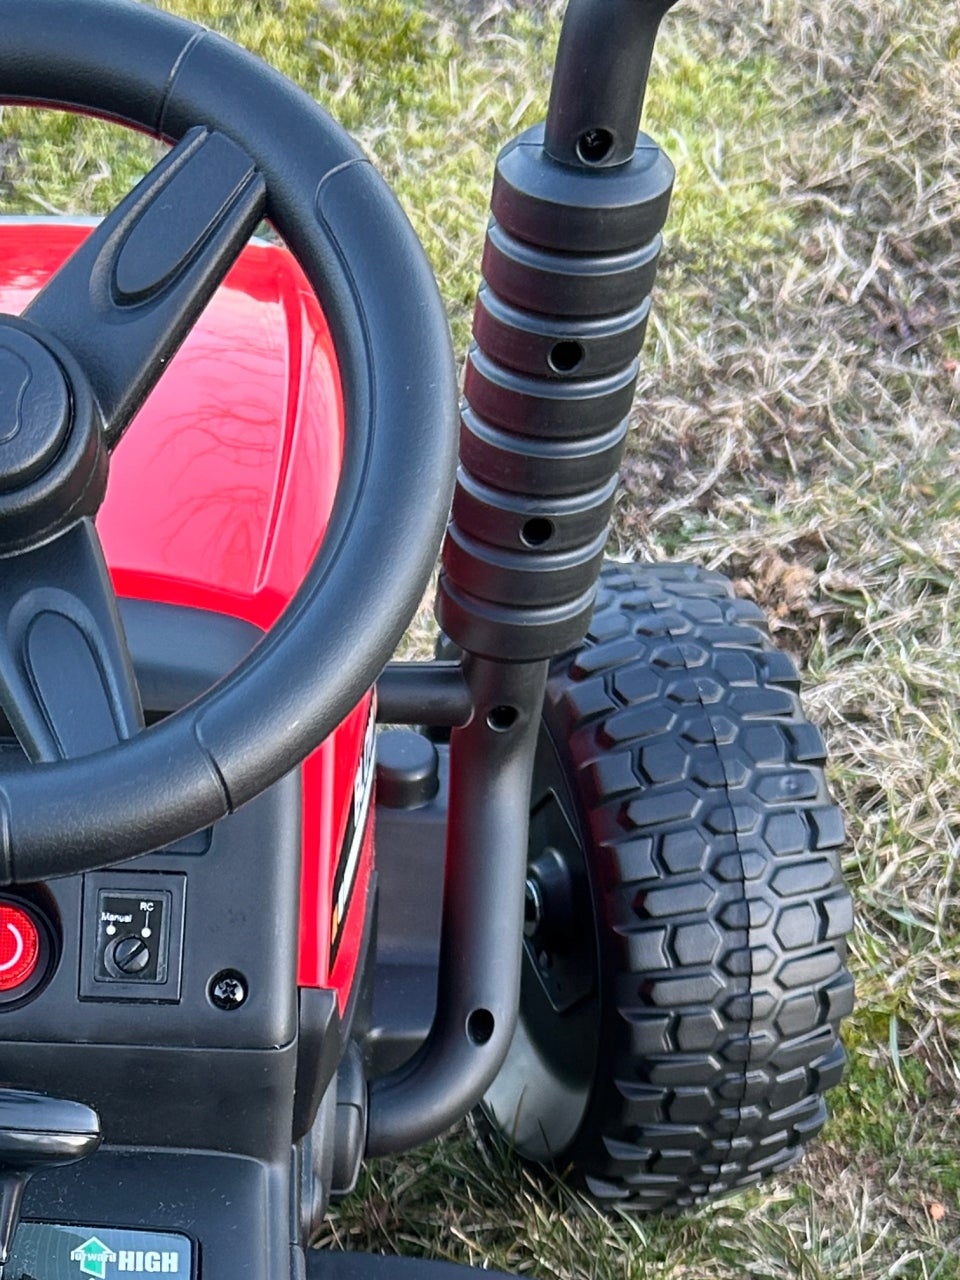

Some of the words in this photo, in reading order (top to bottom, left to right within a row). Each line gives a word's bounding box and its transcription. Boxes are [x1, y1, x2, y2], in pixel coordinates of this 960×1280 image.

[140, 902, 154, 911] RC
[101, 912, 132, 923] Manual
[118, 1250, 179, 1273] HIGH
